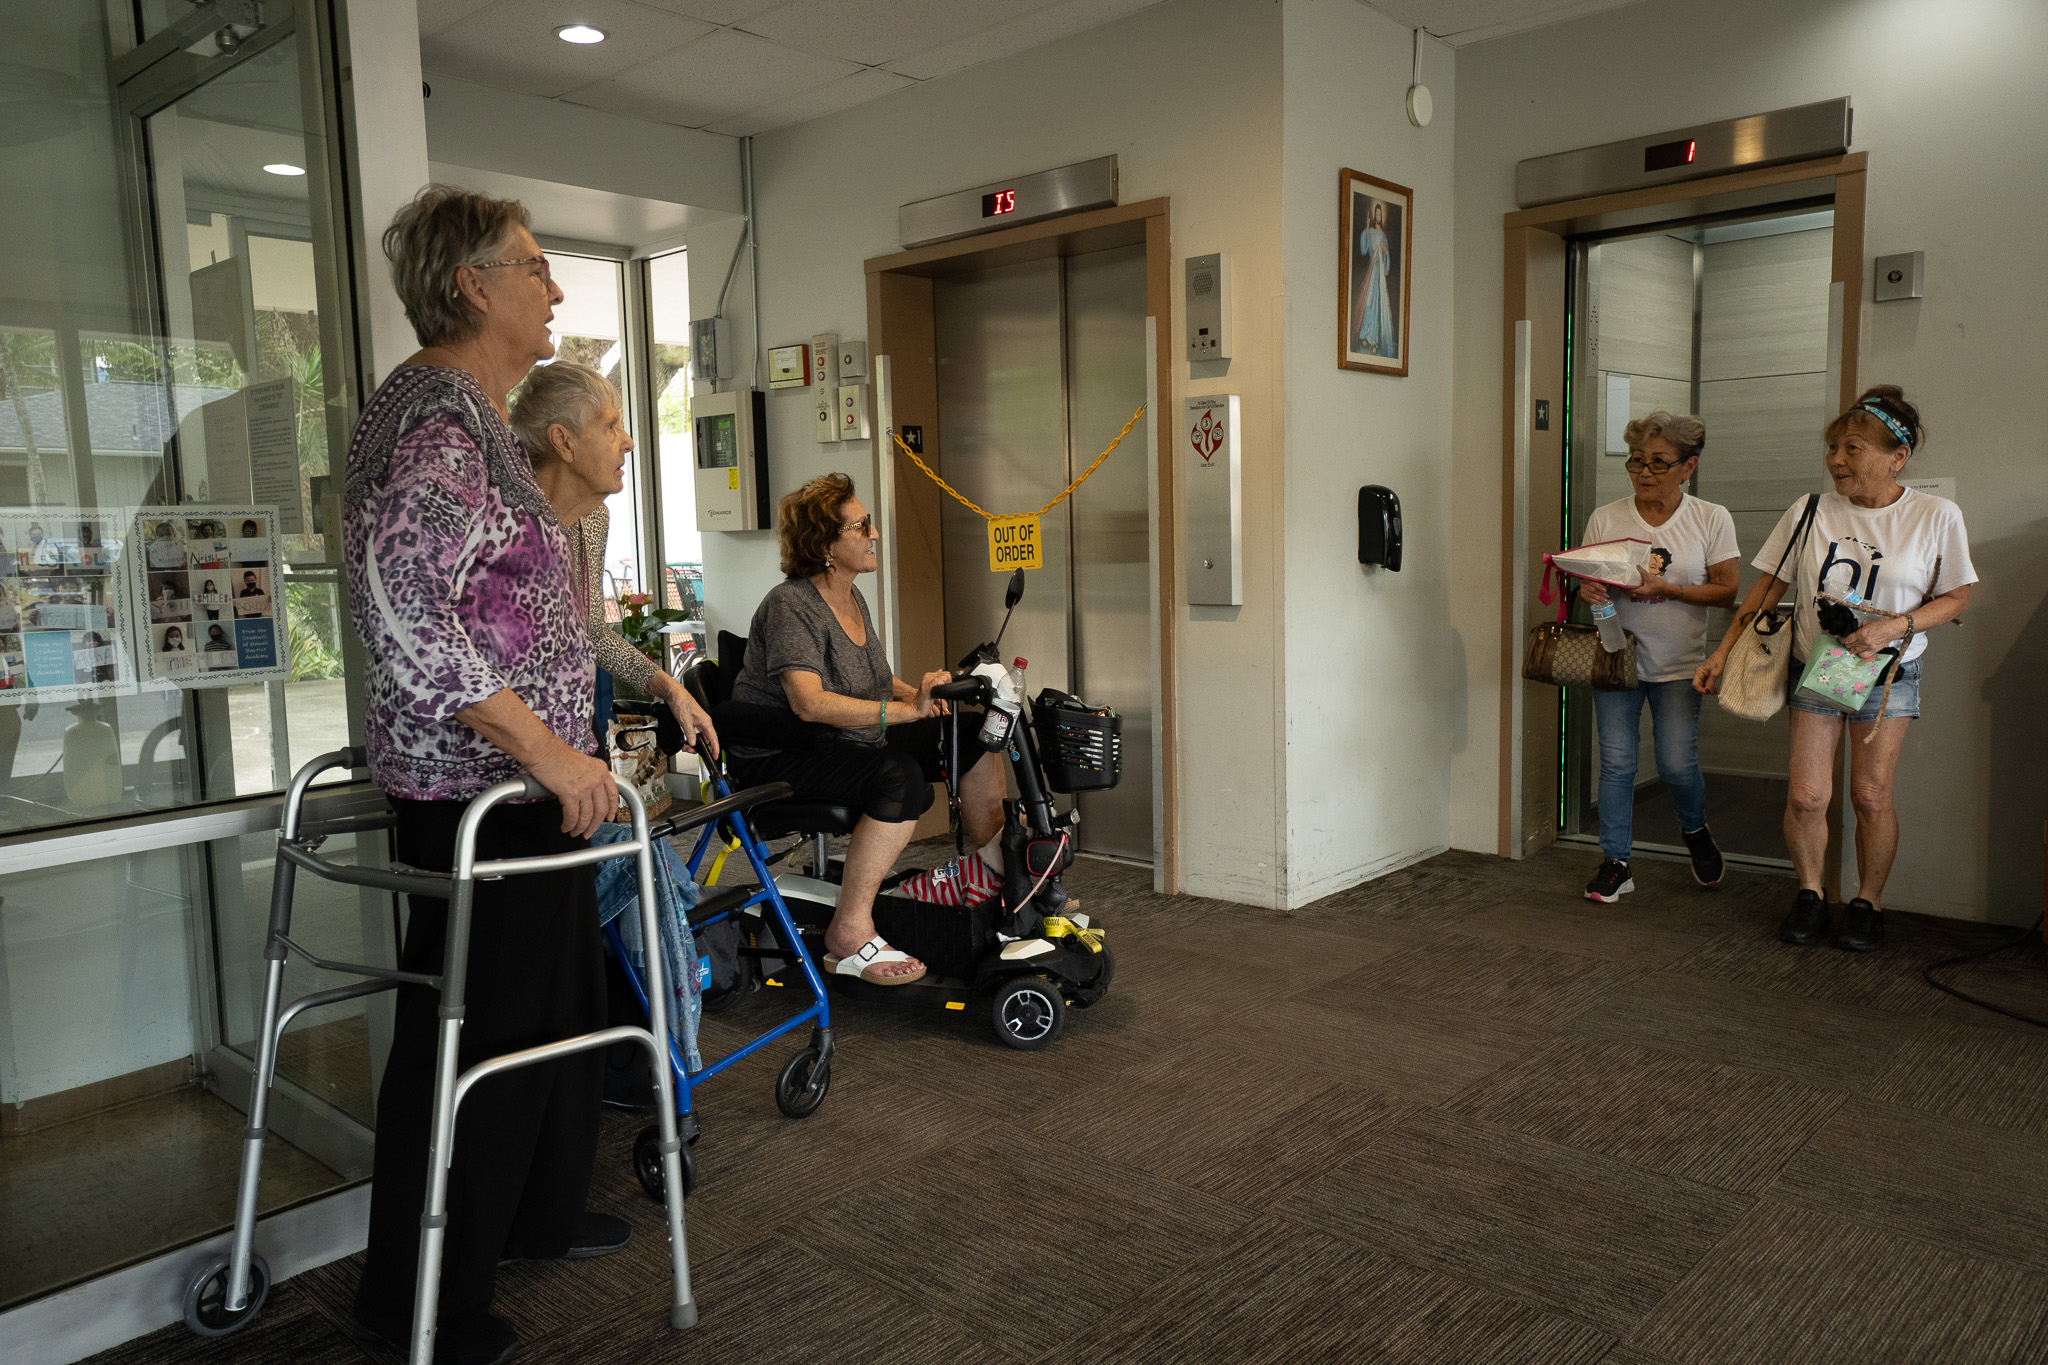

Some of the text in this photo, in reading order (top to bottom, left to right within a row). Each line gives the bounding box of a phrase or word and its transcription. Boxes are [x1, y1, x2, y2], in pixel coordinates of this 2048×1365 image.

[1688, 141, 1695, 161] 1
[994, 524, 1034, 543] OUT OF
[996, 544, 1035, 562] ORDER
